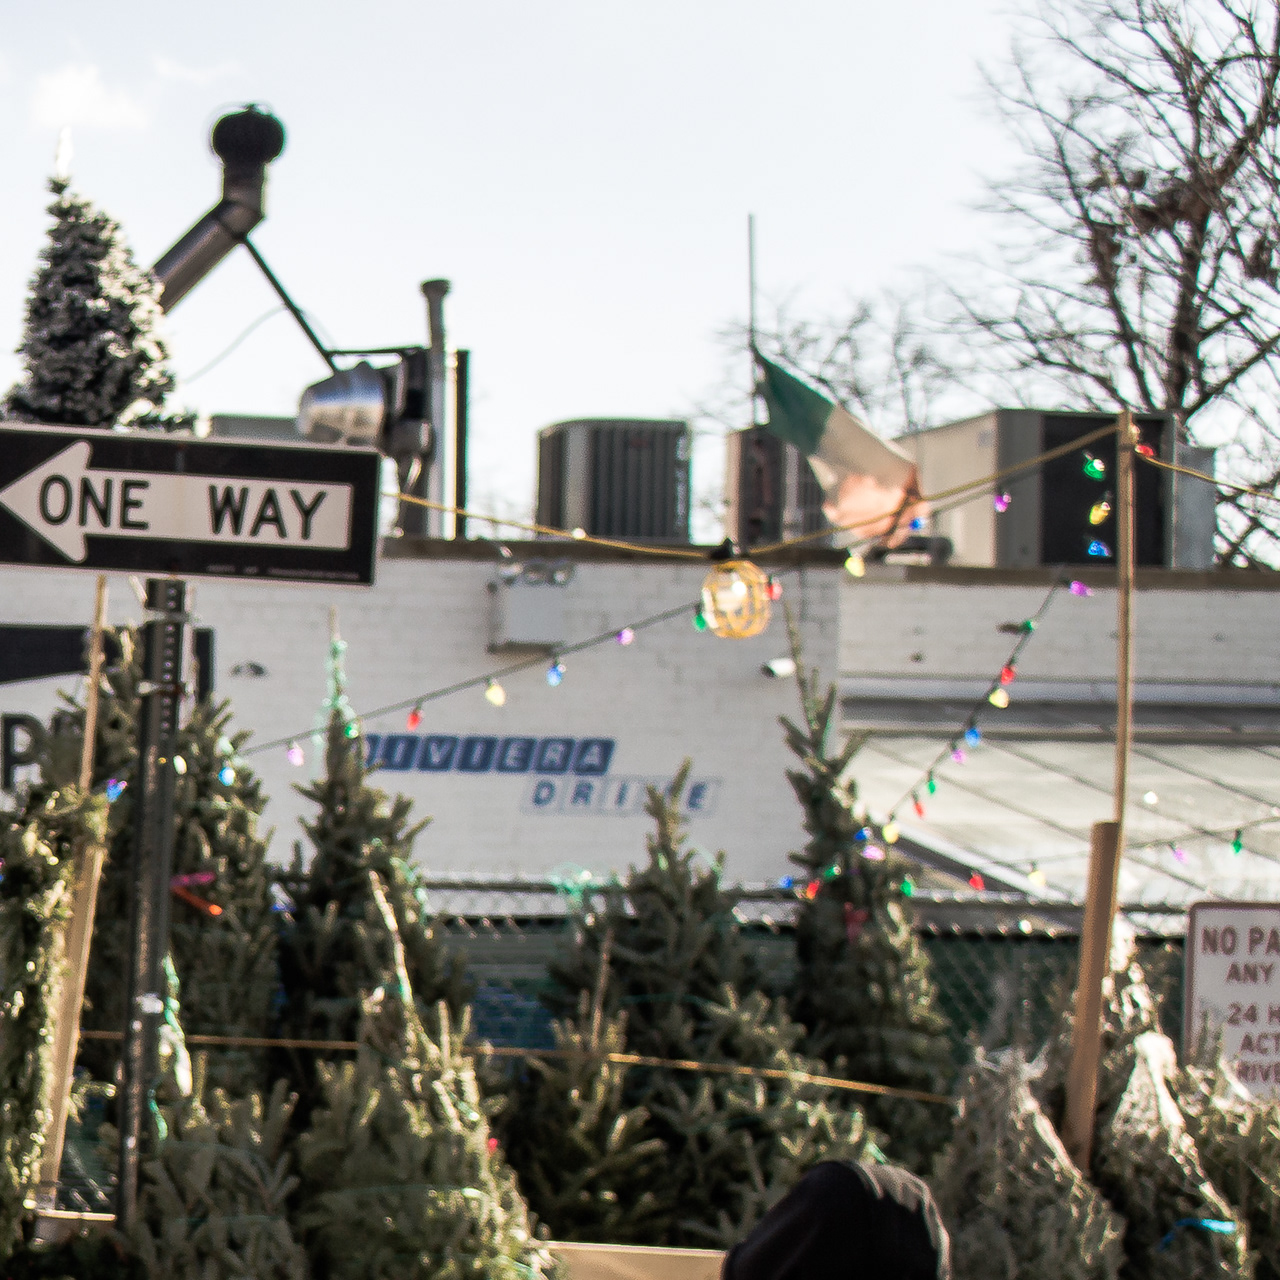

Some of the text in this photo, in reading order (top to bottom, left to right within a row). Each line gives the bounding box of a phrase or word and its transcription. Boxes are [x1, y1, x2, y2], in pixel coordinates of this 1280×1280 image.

[40, 473, 328, 541] ONE WAY
[532, 779, 709, 811] DRIE
[1201, 926, 1237, 956] NO
[1225, 962, 1274, 984] ANY
[1226, 1002, 1258, 1027] 24
